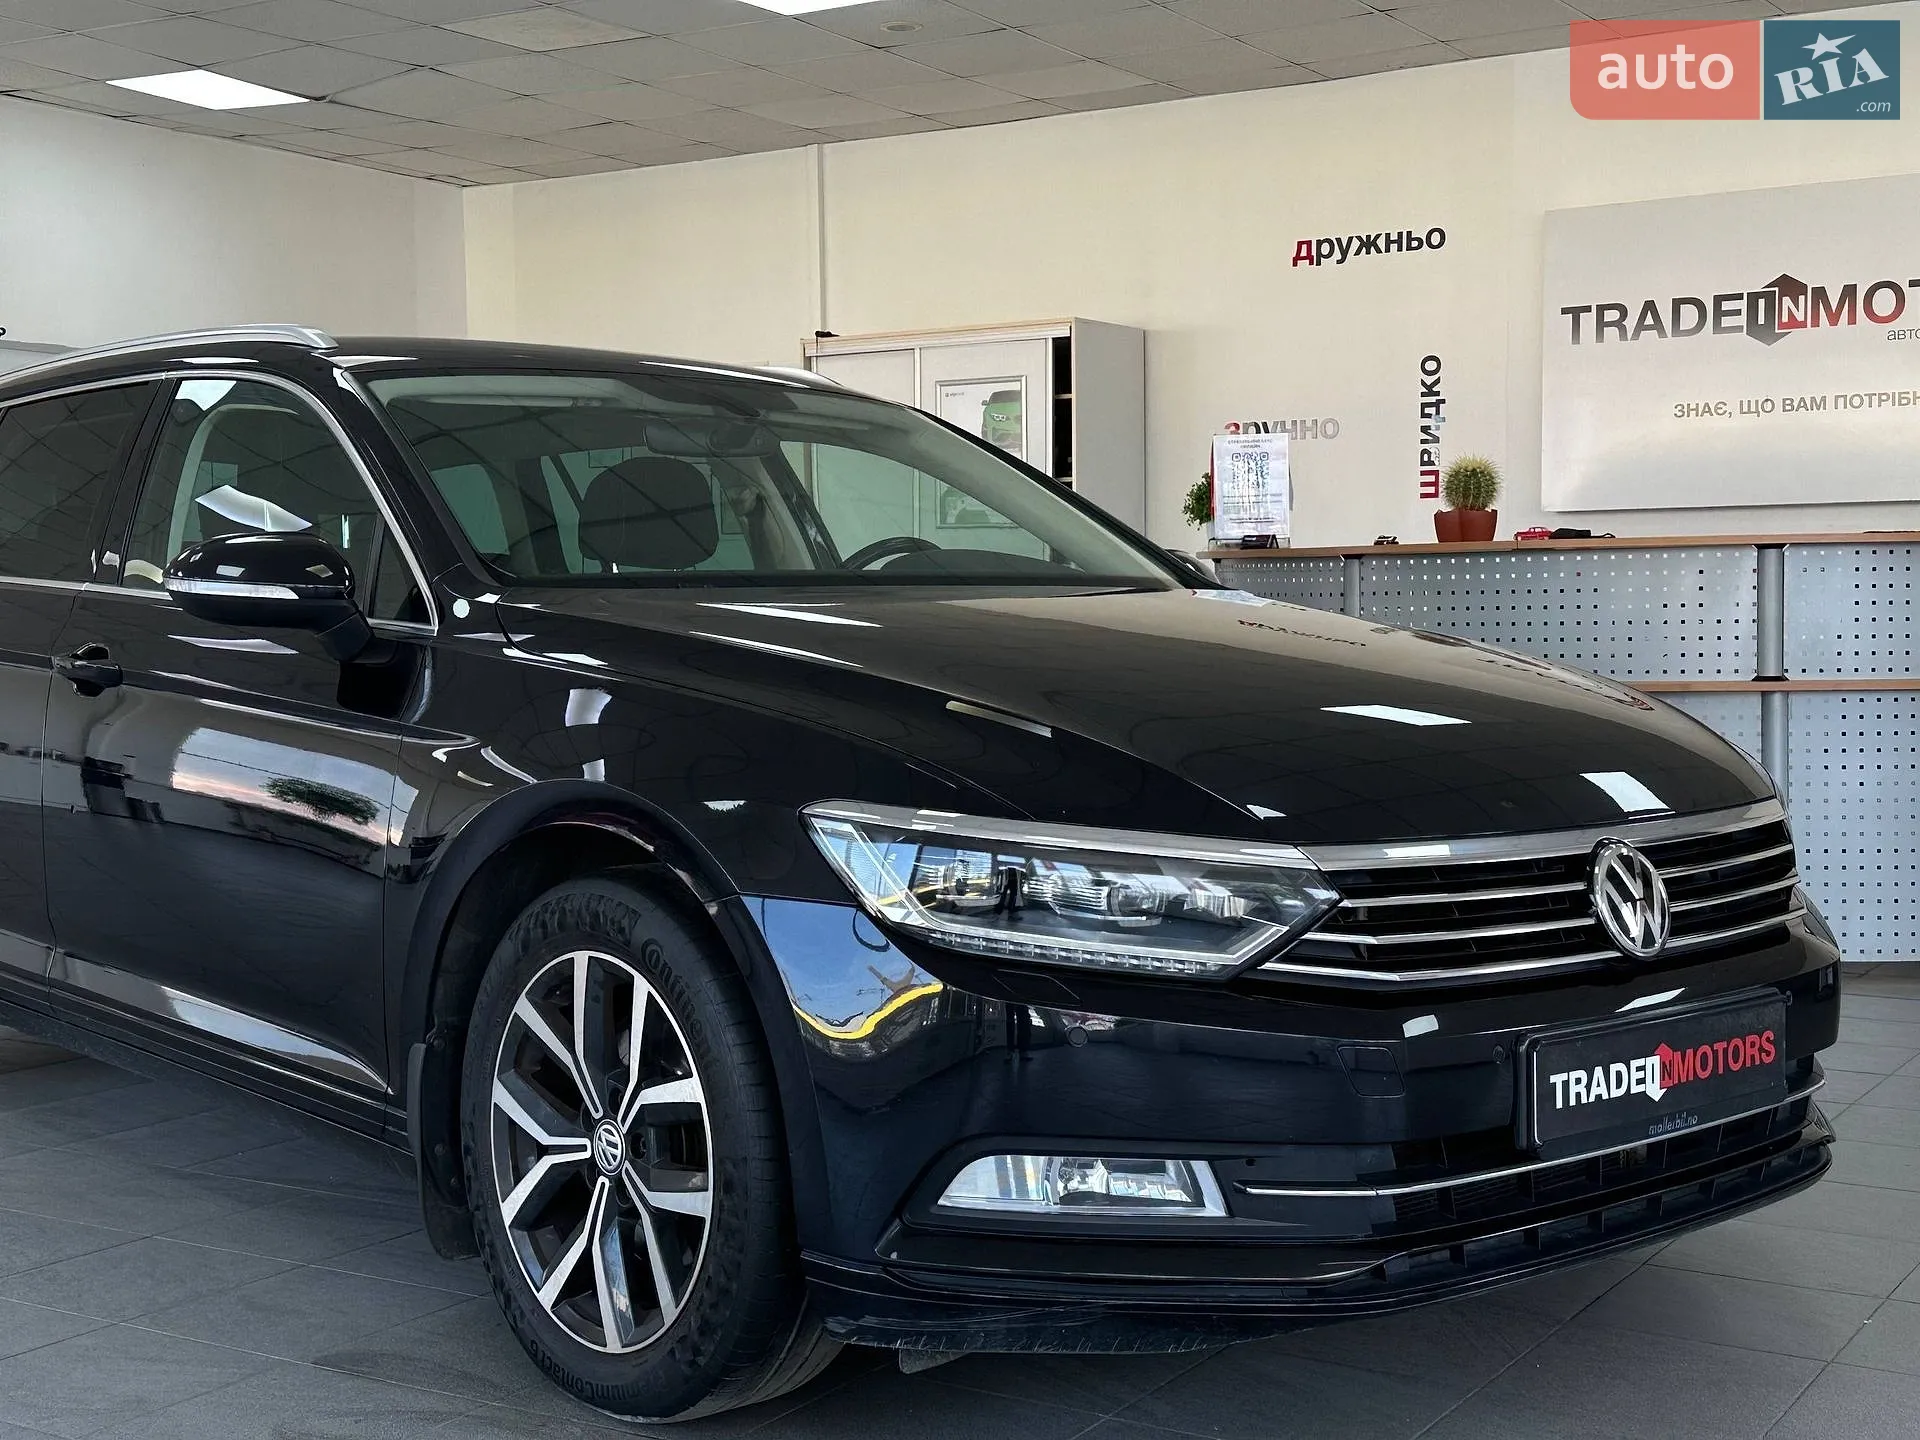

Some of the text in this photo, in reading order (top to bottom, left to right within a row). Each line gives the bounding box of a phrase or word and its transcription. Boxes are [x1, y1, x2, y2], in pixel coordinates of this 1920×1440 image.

[1292, 227, 1446, 267] дружньо
[1673, 401, 1733, 419] ЗНАЄ,
[1739, 397, 1776, 417] ЩО
[1782, 395, 1828, 413] ВАМ
